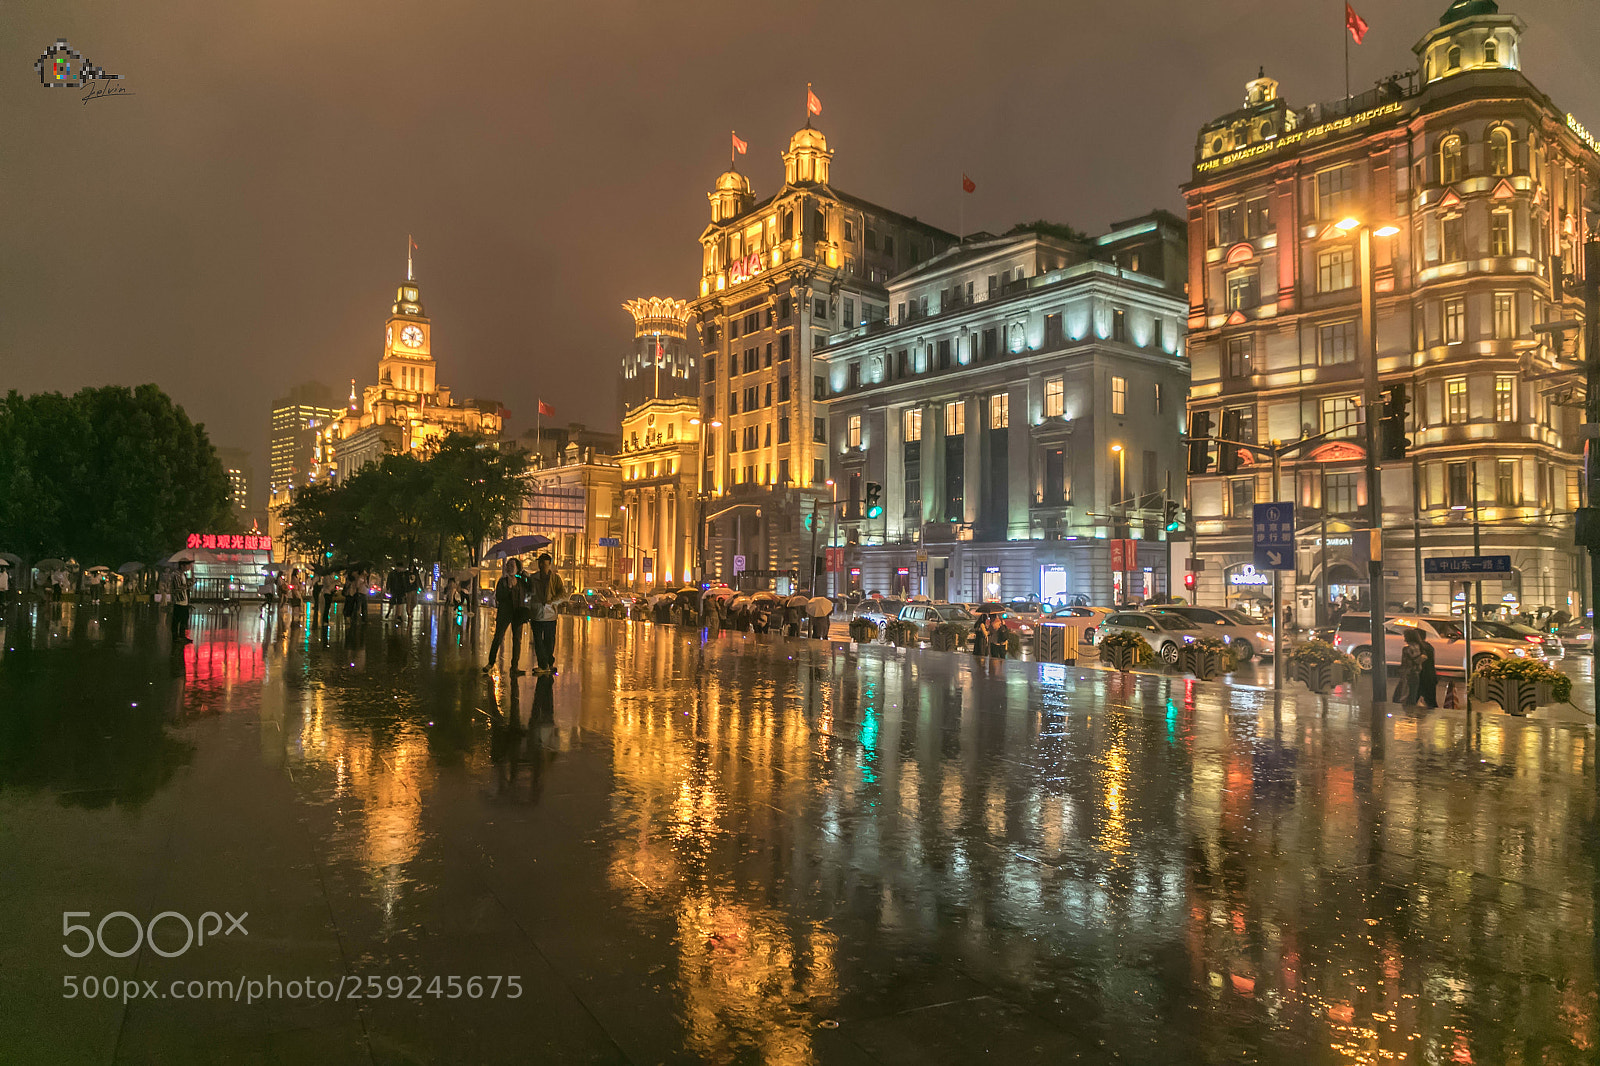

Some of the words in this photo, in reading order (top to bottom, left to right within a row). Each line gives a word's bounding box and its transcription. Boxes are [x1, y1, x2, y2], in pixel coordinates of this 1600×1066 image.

[1196, 158, 1220, 172] THE
[1222, 141, 1274, 165] SWATCH
[1276, 131, 1304, 148] ART
[1306, 116, 1352, 139] PEACE
[1354, 101, 1403, 123] HOTEL
[730, 252, 762, 284] AIA
[187, 533, 272, 551] 外滩观光隧道
[1439, 560, 1494, 571] 中山东一路
